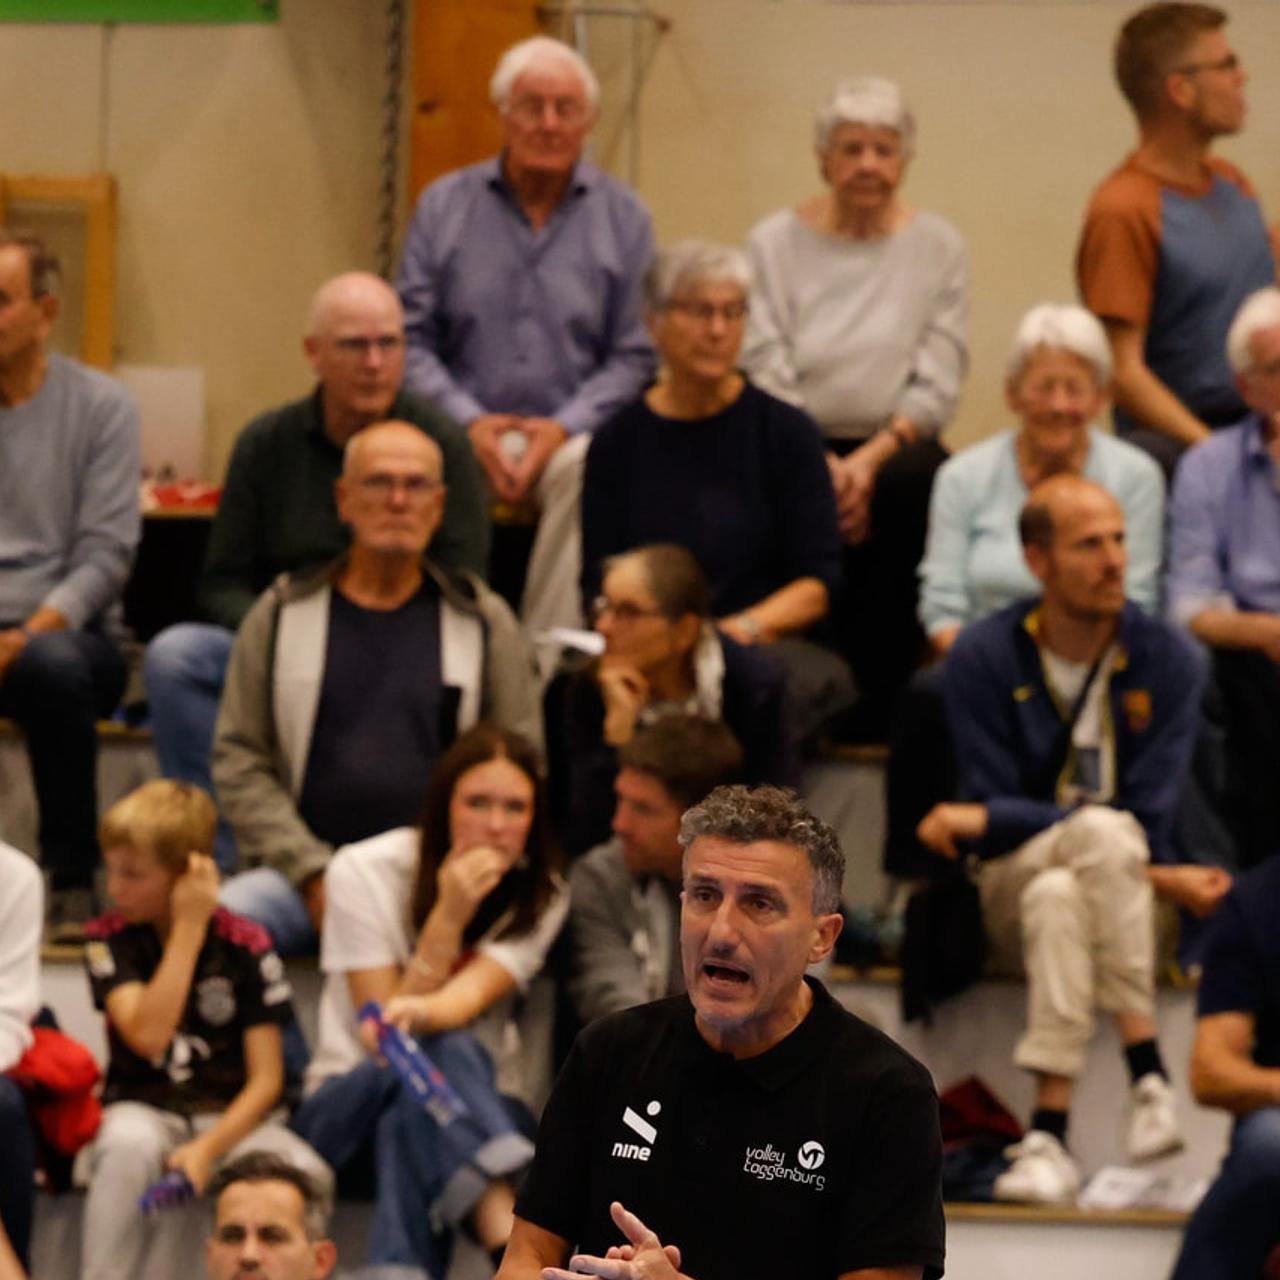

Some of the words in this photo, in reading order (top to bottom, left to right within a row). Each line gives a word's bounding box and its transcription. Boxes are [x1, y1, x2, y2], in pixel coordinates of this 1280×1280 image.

[611, 1142, 652, 1162] nine
[744, 1143, 786, 1168] volley
[742, 1156, 826, 1192] toggenburg
